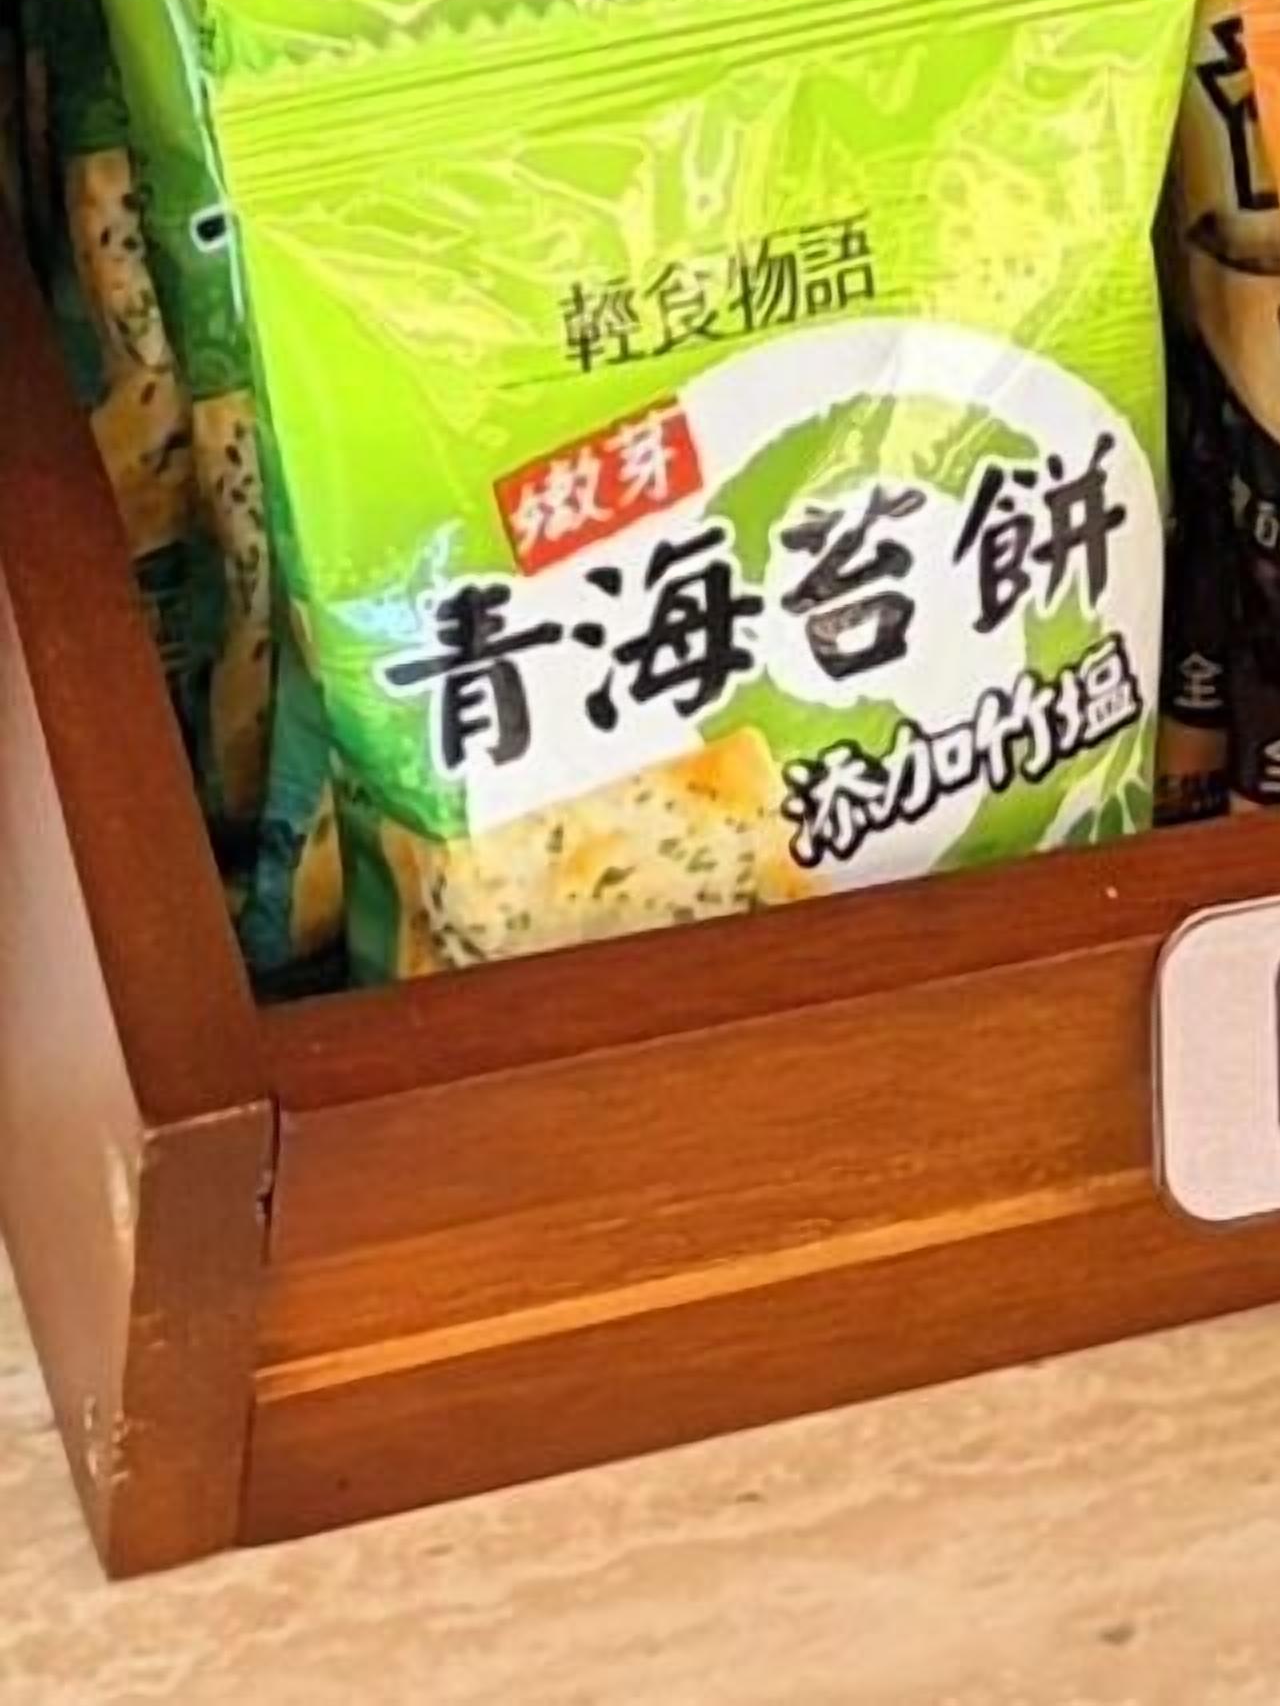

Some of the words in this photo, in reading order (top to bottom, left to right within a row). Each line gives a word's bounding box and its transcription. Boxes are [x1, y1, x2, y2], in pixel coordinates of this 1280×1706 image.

[561, 220, 876, 373] 輕食物語
[508, 412, 682, 552] 嫩芽
[385, 433, 1127, 770] 青海苔餅
